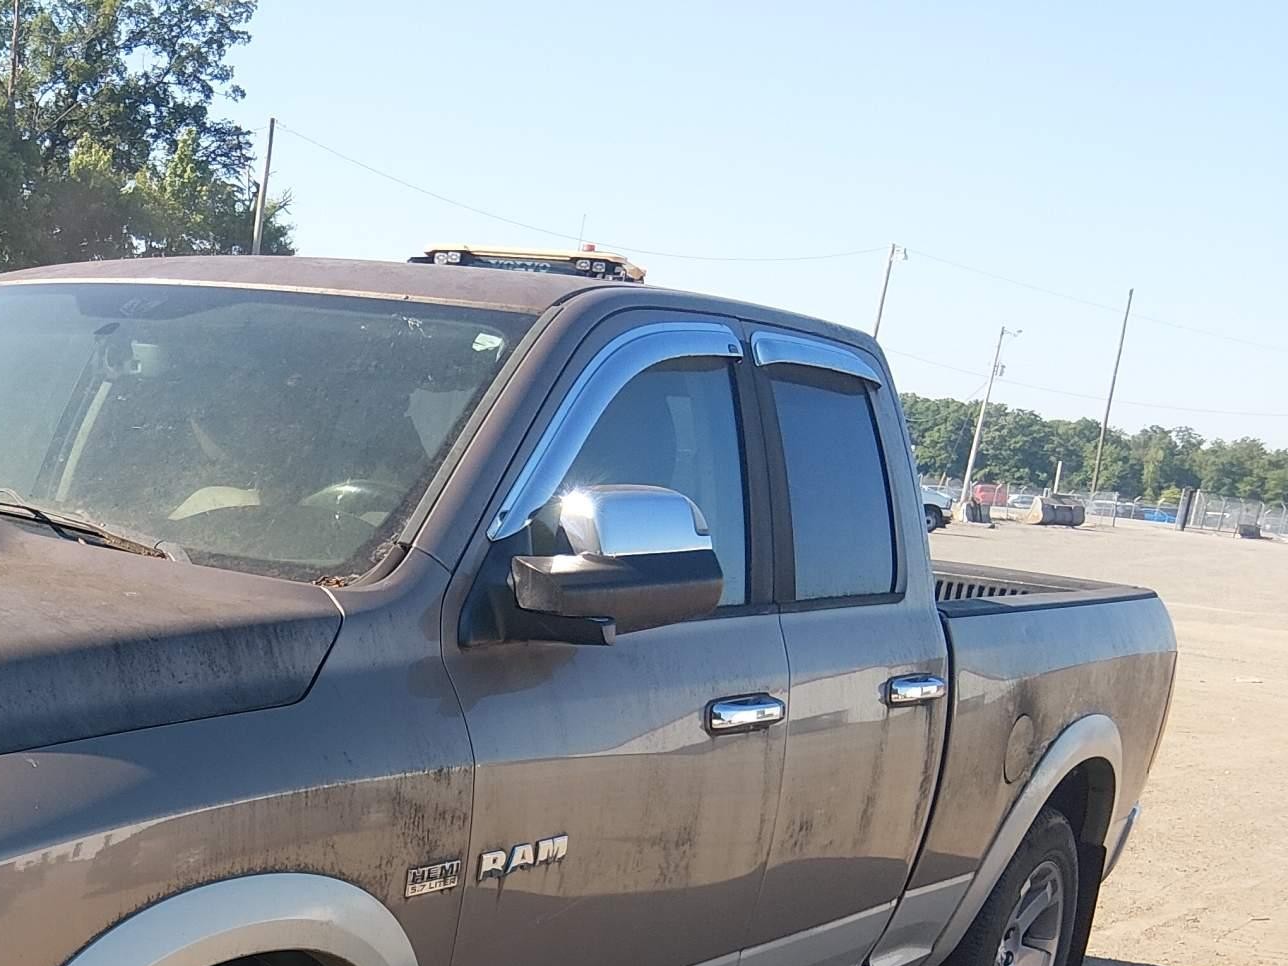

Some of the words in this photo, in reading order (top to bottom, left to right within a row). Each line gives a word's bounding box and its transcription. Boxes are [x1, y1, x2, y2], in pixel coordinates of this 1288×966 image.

[479, 834, 569, 880] RAM
[410, 861, 460, 885] HEMI
[409, 884, 426, 895] 5.7
[428, 876, 457, 890] LITER
